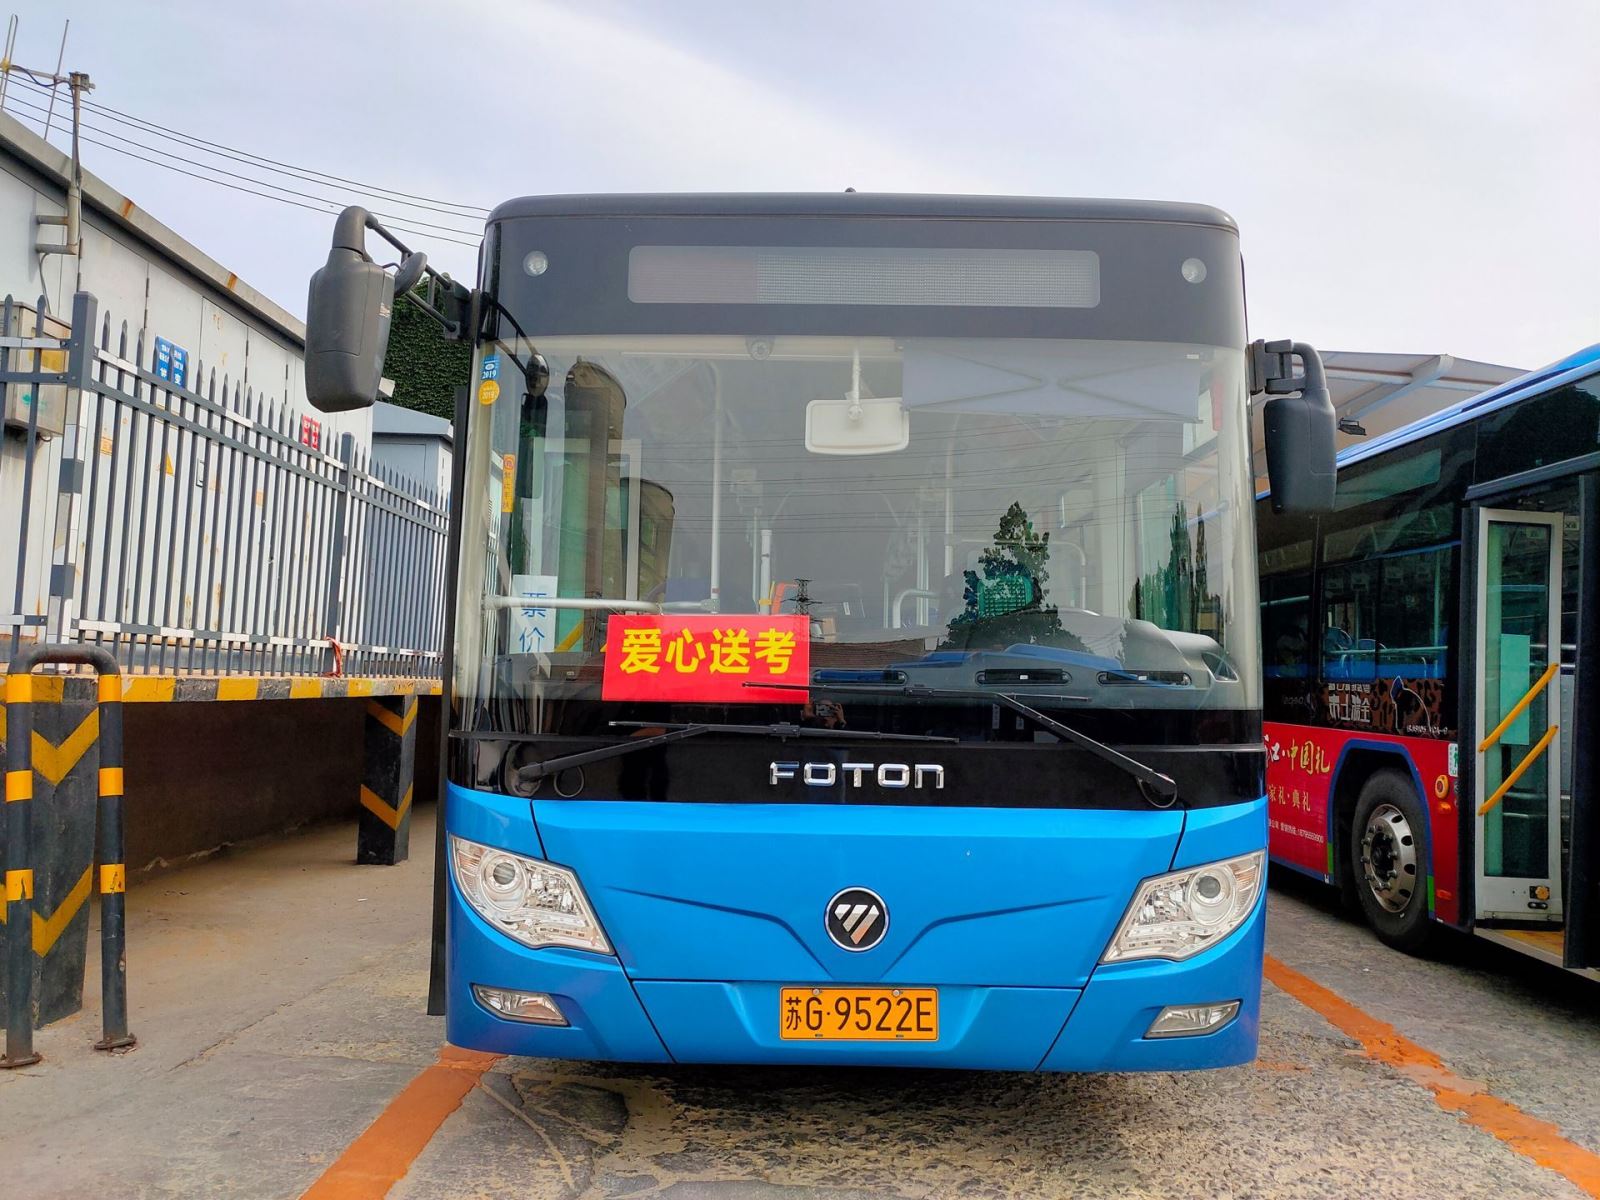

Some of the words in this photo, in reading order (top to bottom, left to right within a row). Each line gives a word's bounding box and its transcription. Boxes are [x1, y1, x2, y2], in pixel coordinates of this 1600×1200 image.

[481, 370, 497, 380] 2019
[619, 627, 797, 675] 爱心送考
[768, 761, 945, 789] FOTON
